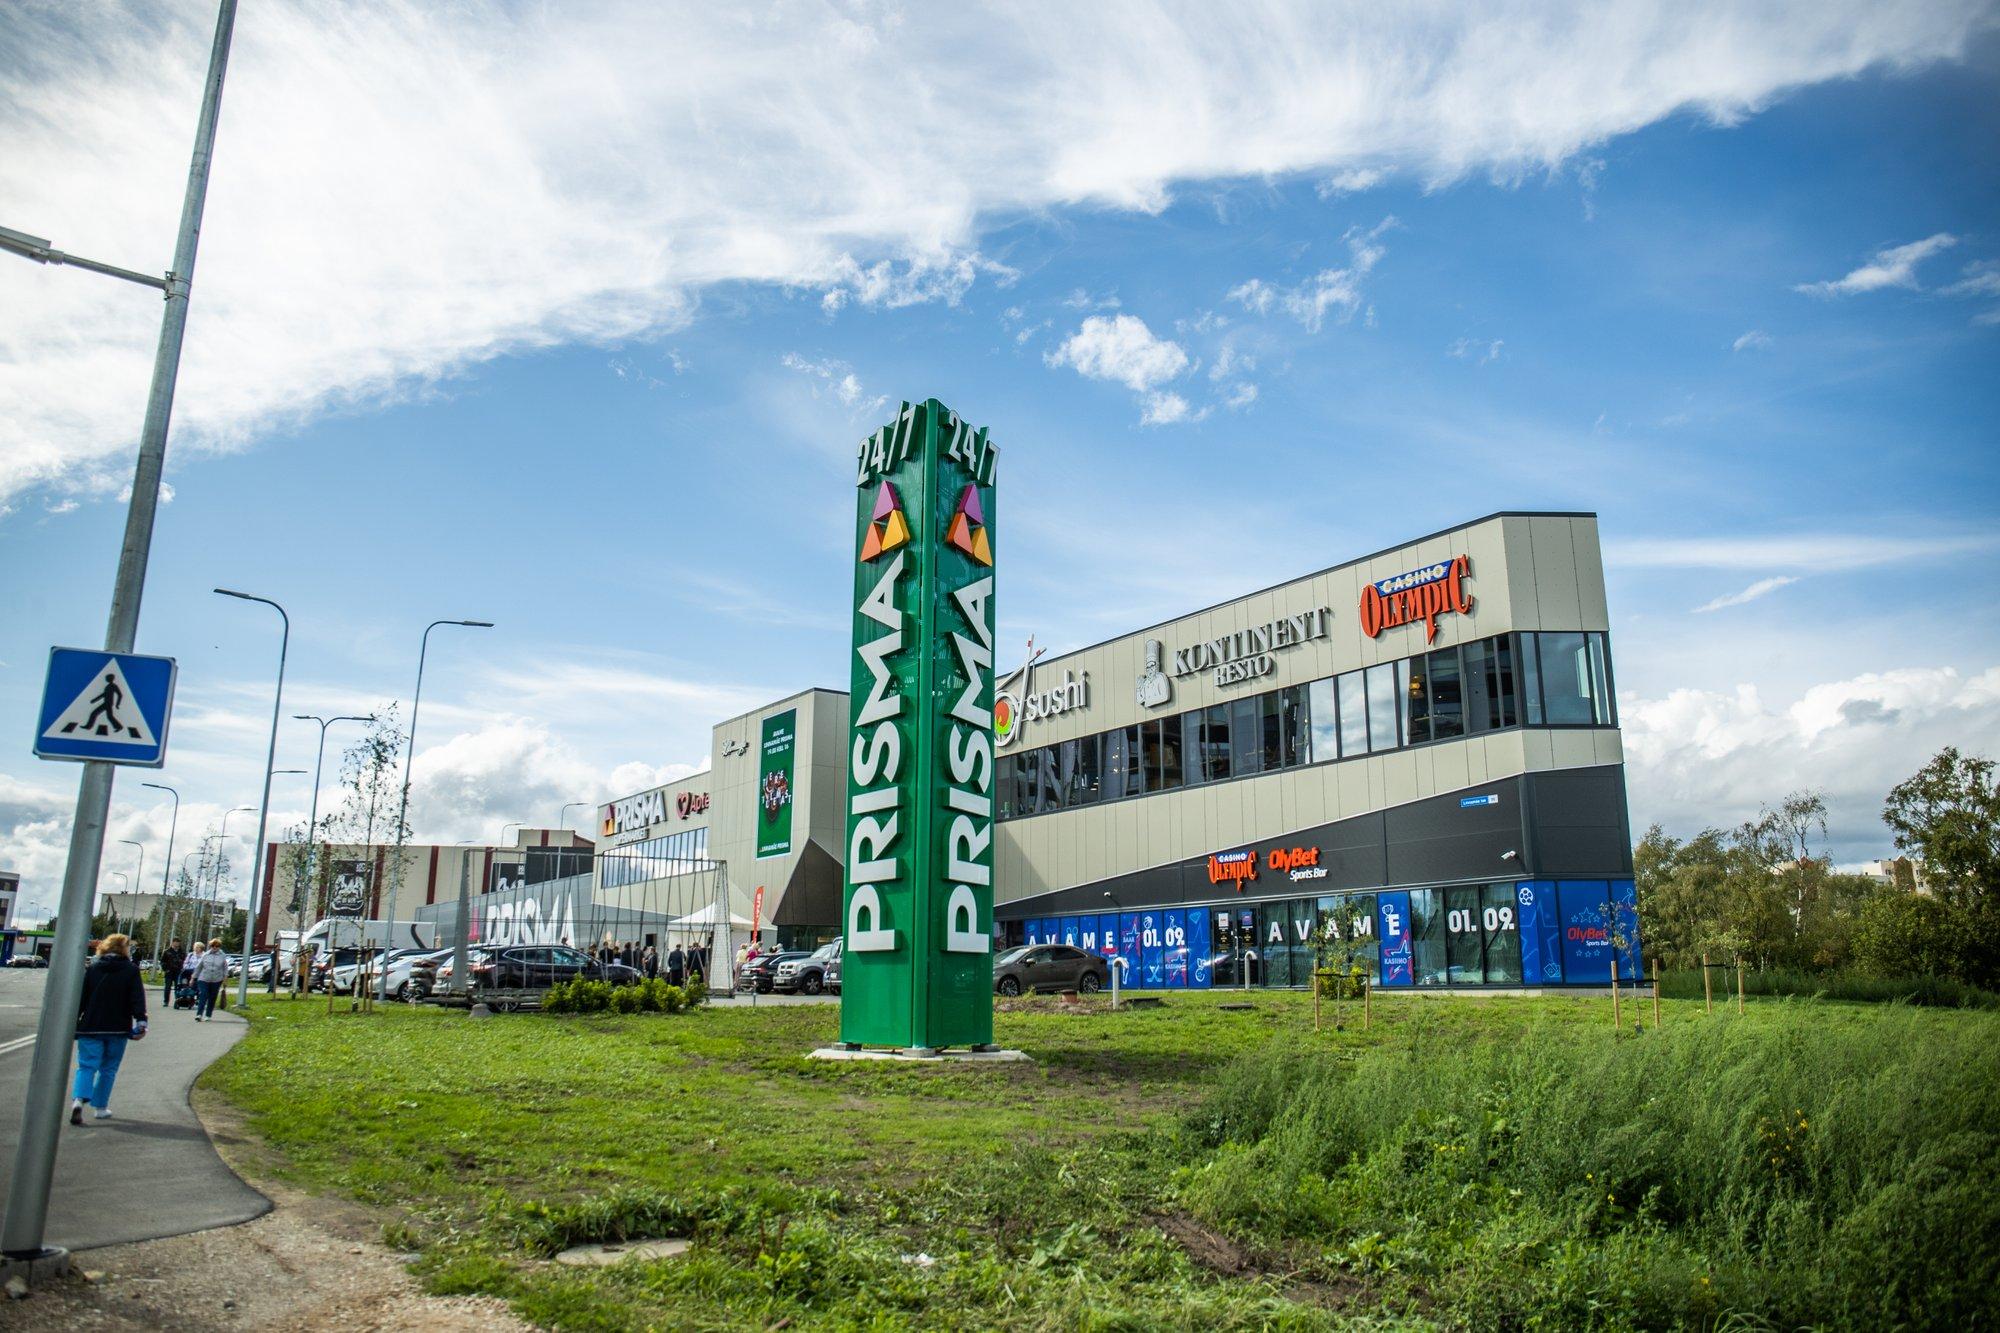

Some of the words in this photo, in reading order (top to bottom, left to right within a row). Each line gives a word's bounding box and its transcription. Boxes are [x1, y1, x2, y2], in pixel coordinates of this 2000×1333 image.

[857, 400, 916, 487] 24/7
[949, 409, 1001, 487] 24/7
[1382, 562, 1446, 593] CASINO
[1173, 606, 1331, 677] KONTINENT
[1213, 651, 1274, 687] RESTO
[1026, 667, 1086, 721] sushi
[848, 549, 904, 951] PRISMA
[947, 575, 993, 954] PRISMA
[614, 788, 665, 833] PRISMA
[1218, 853, 1248, 863] CASINO
[1269, 846, 1319, 873] OlyBet
[1289, 869, 1313, 882] Sports
[1313, 867, 1328, 879] Bar
[1268, 913, 1400, 942] AVAME
